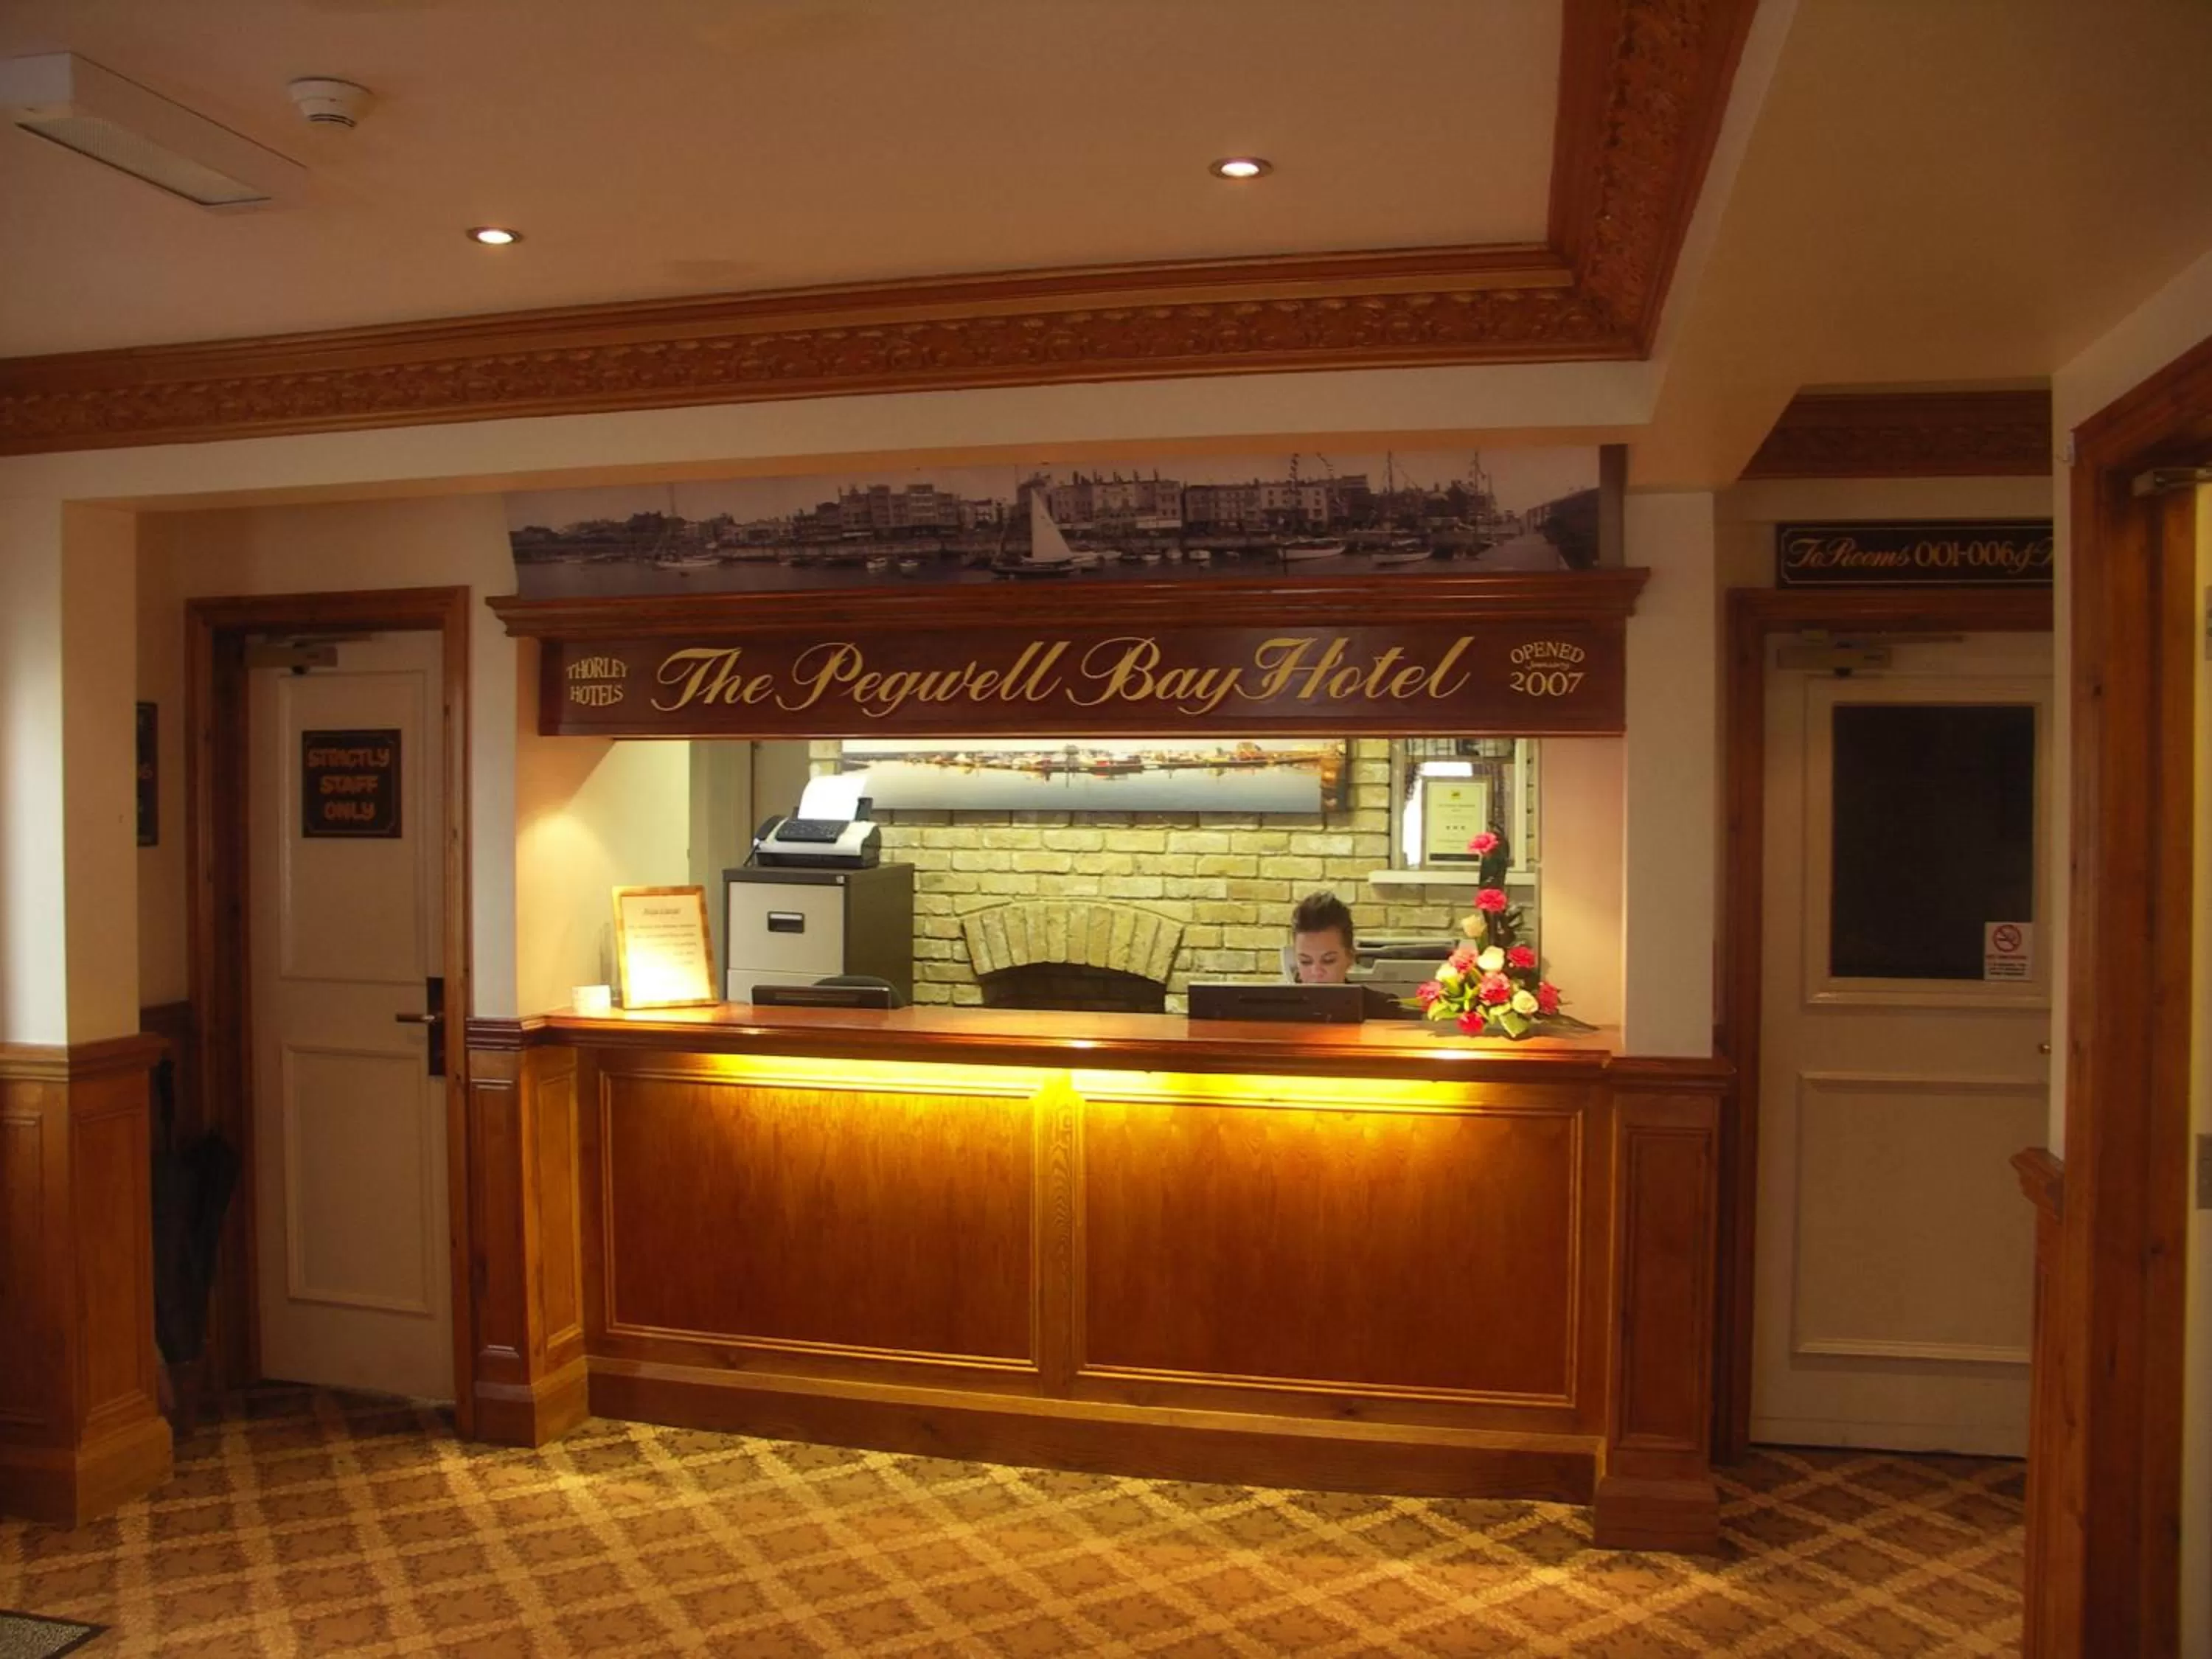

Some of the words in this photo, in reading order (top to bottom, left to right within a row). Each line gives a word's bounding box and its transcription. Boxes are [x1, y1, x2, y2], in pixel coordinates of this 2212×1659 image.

[1786, 537, 1826, 568] To
[1823, 537, 1912, 568] Rooms
[1510, 641, 1585, 664] OPENED
[566, 656, 628, 679] THORLEY
[650, 647, 773, 712] The
[776, 641, 1071, 717] Pegwell
[1066, 636, 1240, 714] Bay
[1234, 636, 1474, 702] Hotel
[569, 684, 625, 706] HOTELS
[1509, 672, 1585, 697] 2007
